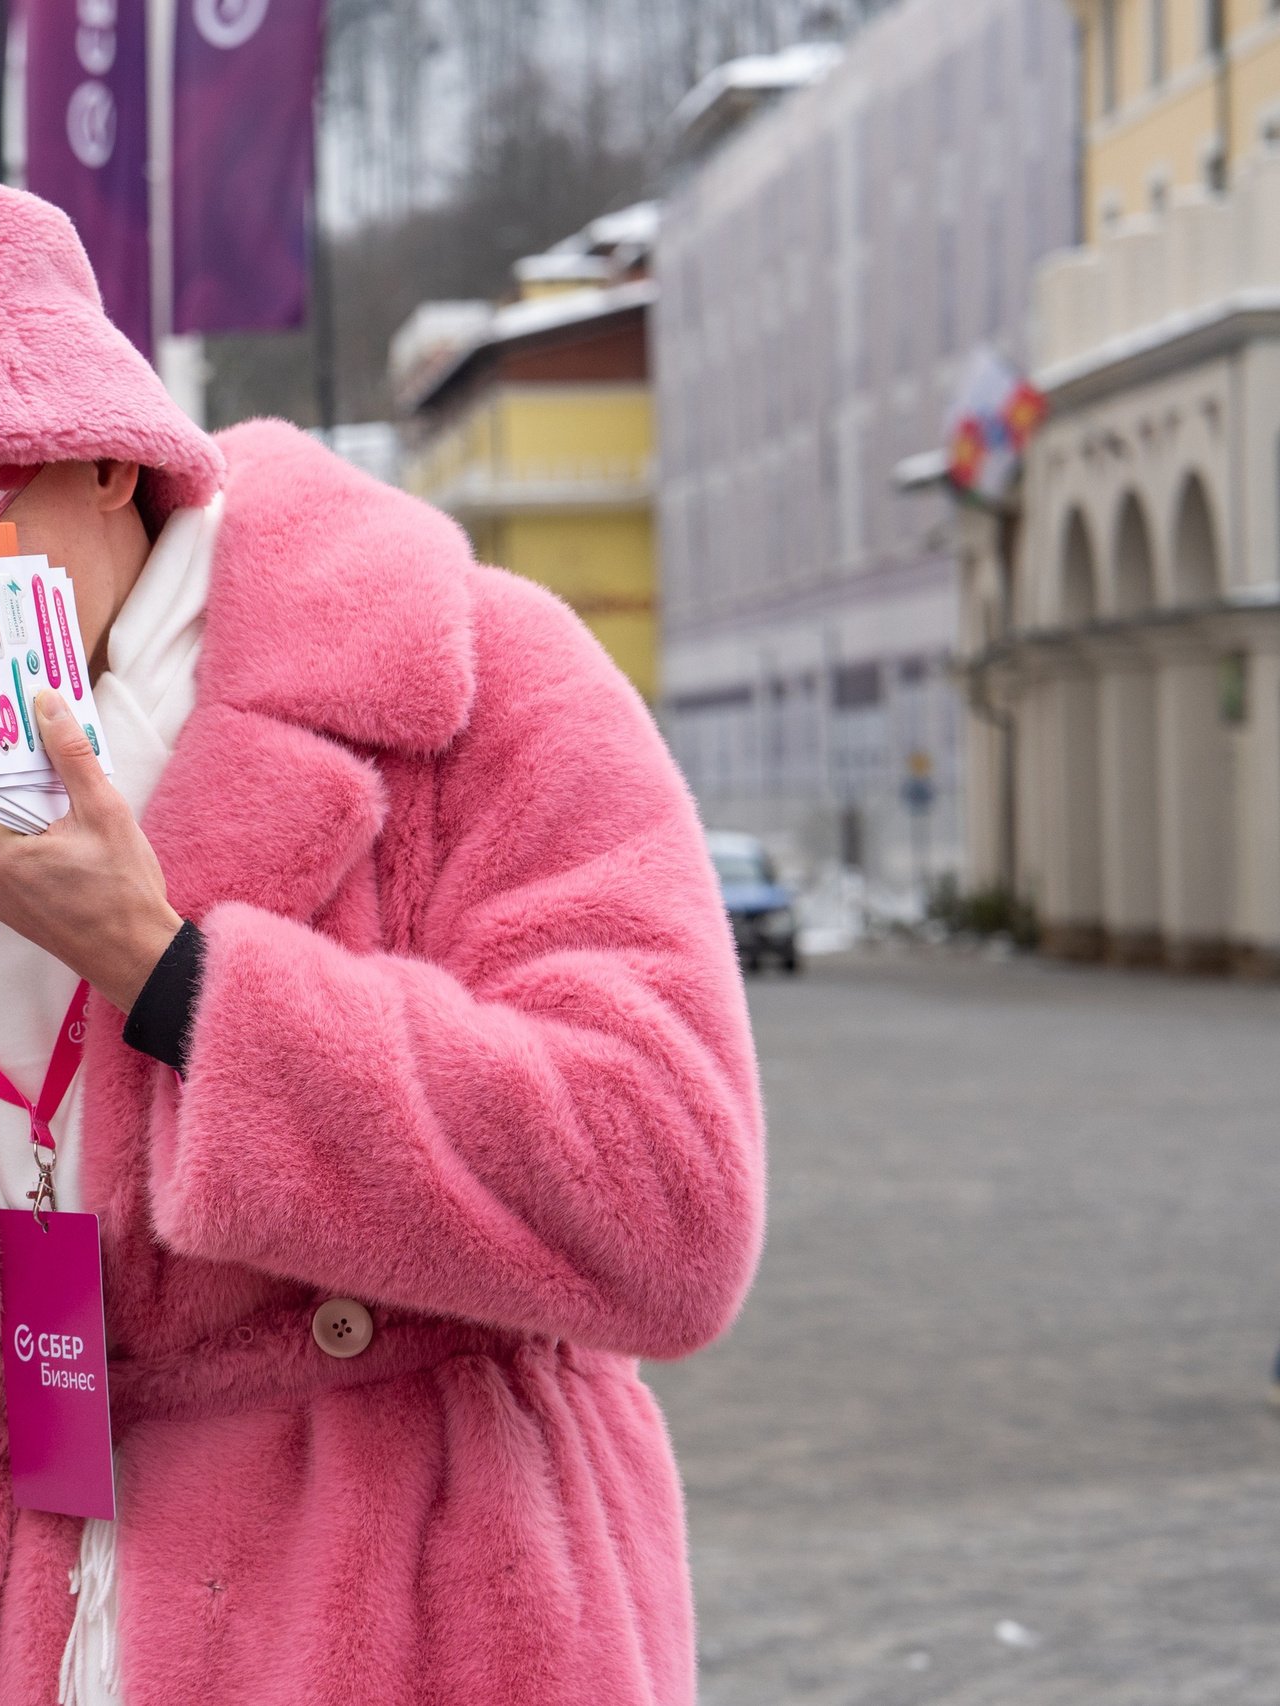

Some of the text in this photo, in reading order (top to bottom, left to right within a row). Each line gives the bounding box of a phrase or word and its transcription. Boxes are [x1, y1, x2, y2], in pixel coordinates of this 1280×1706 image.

[37, 584, 58, 677] БИЗНЕС MOOD
[55, 597, 80, 688] БИЗНЕС MOOD
[38, 1333, 84, 1360] СБЕР
[40, 1362, 96, 1391] Бизнес
